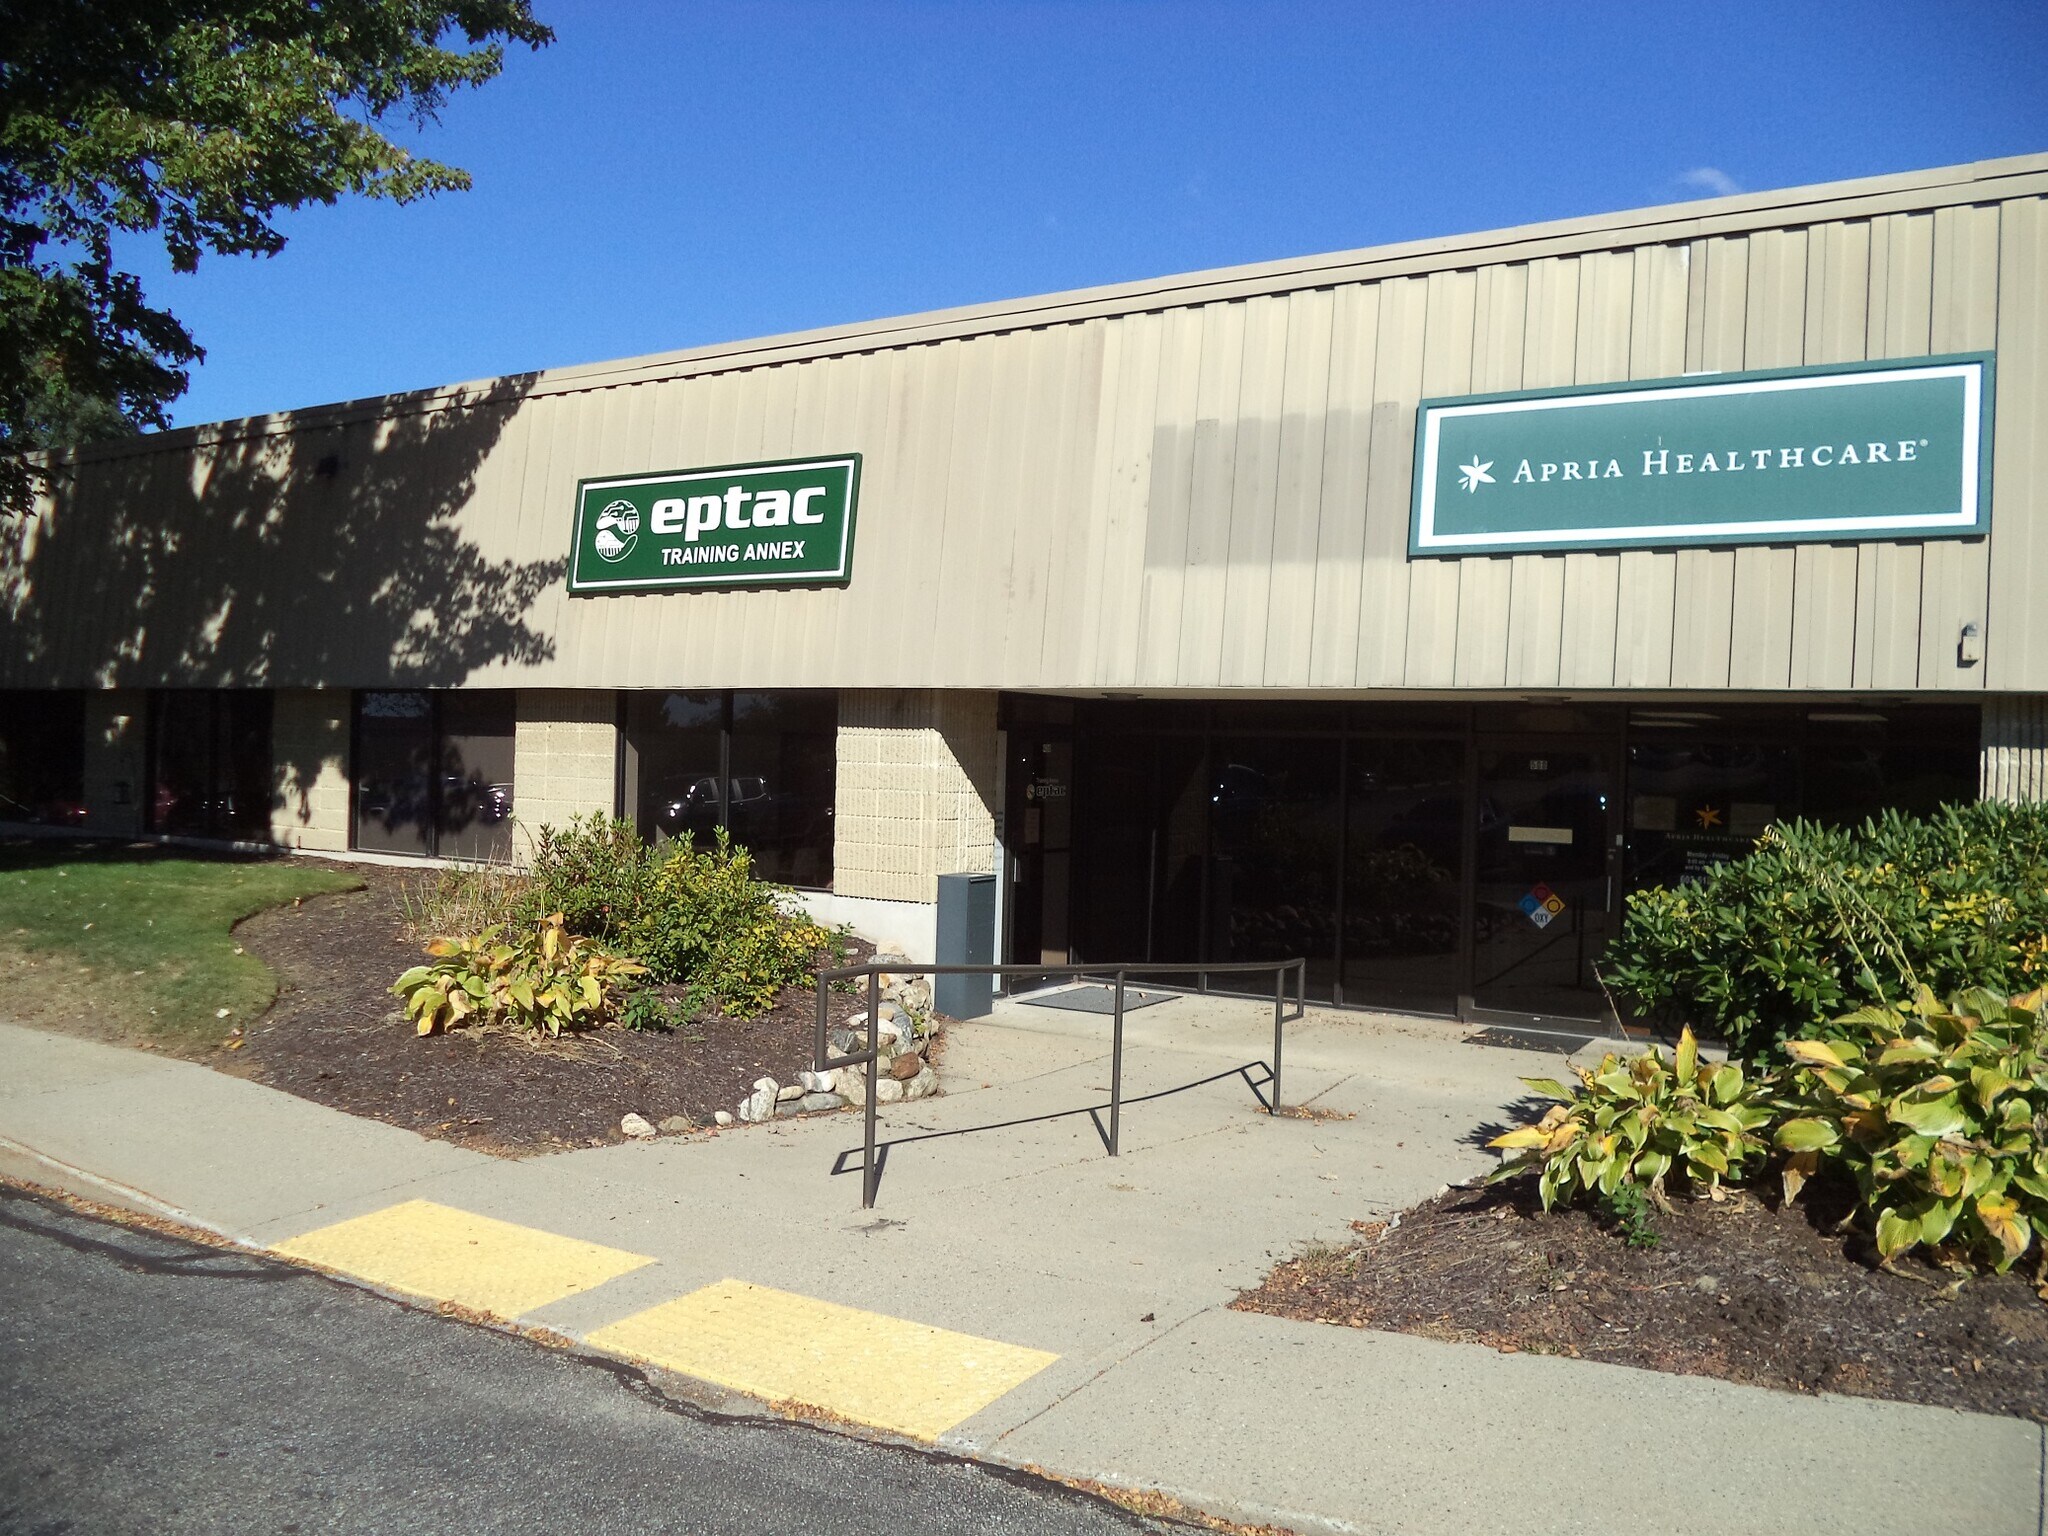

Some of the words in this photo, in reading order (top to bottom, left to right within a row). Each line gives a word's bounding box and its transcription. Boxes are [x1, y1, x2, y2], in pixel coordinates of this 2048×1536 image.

[1513, 459, 1623, 483] APRIA
[651, 486, 825, 542] eptac
[662, 545, 739, 565] TRAINING
[744, 541, 805, 560] ANNEX
[1535, 913, 1549, 923] OXY
